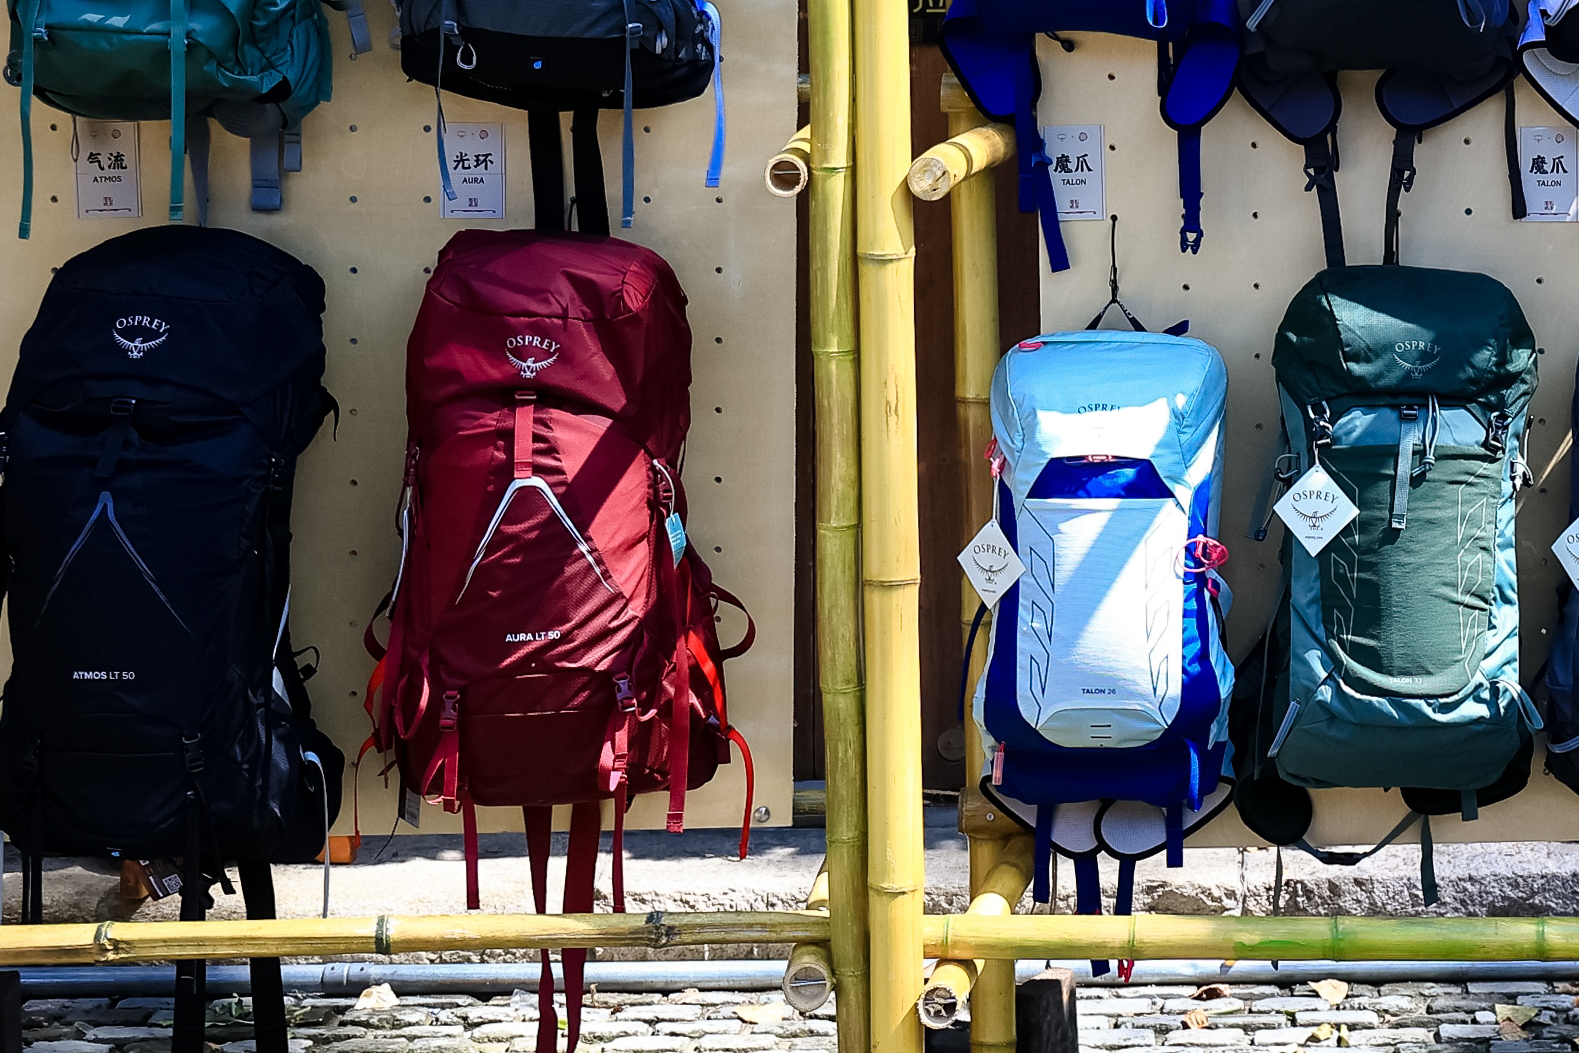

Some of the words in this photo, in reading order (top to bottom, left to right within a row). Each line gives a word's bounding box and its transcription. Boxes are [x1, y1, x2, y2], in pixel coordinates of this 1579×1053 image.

[86, 151, 128, 172] 气流
[452, 152, 494, 172] 光环
[1053, 153, 1094, 174] 魔爪
[1528, 154, 1568, 176] 魔爪
[92, 175, 122, 184] ATMOS
[461, 176, 485, 185] AURA
[1061, 177, 1087, 186] TALON
[1536, 179, 1562, 188] TALON
[115, 315, 170, 334] OSPREY
[506, 335, 560, 352] OSPREY
[1394, 339, 1441, 356] OSPREY
[1292, 490, 1339, 505] OSPREY
[973, 543, 1010, 561] OSPREY
[505, 633, 534, 643] AURA
[535, 632, 546, 641] LT
[547, 630, 561, 640] 50
[72, 671, 108, 680] ATMOS
[109, 671, 120, 680] LT
[121, 671, 135, 680] 50
[1389, 677, 1412, 685] TALON
[1081, 687, 1106, 695] TALON
[1107, 687, 1117, 695] 26
